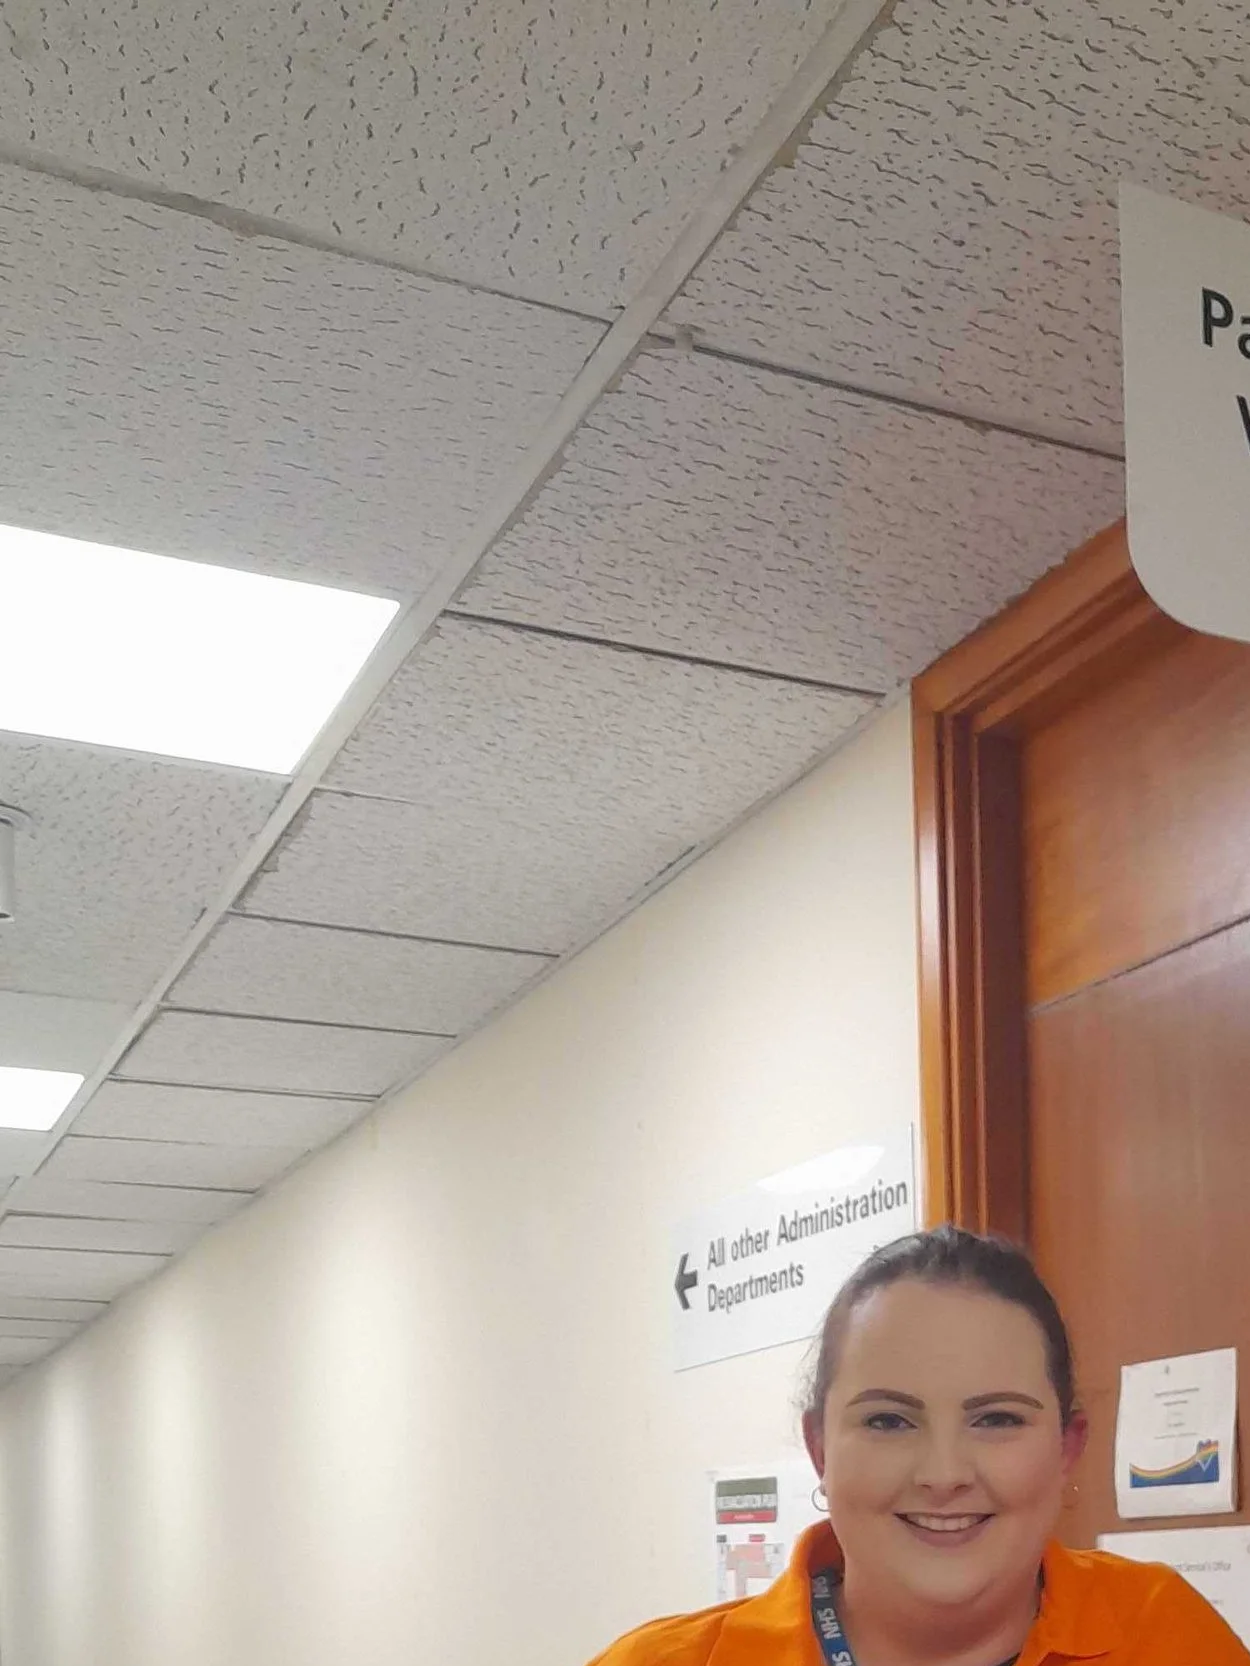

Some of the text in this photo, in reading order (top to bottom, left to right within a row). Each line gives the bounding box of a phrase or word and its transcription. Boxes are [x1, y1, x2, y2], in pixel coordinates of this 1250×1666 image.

[707, 1178, 909, 1271] All other Administration
[707, 1261, 805, 1314] Departments
